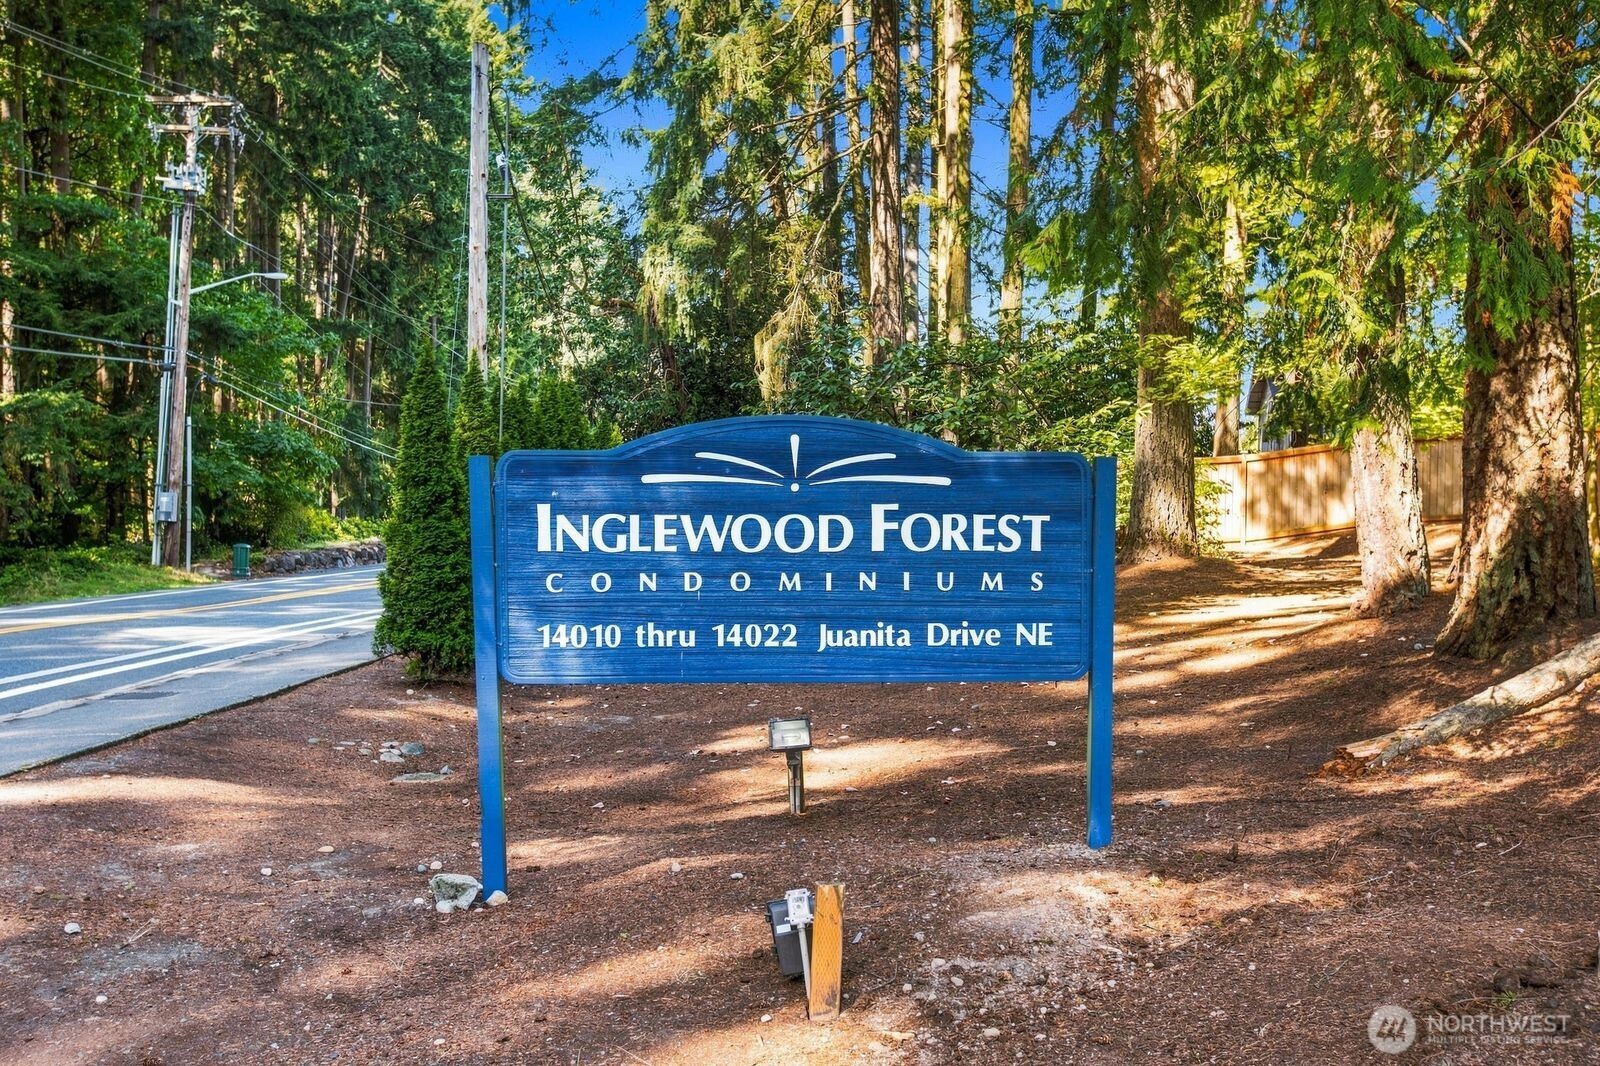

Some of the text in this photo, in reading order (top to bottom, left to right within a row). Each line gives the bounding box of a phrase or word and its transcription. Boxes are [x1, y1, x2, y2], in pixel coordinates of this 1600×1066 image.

[536, 503, 1051, 554] INGLEWOOD FOREST
[545, 571, 1044, 593] CONDOMINIUMS
[538, 620, 1053, 652] 14010 thru 14022 Juanita Drive NE
